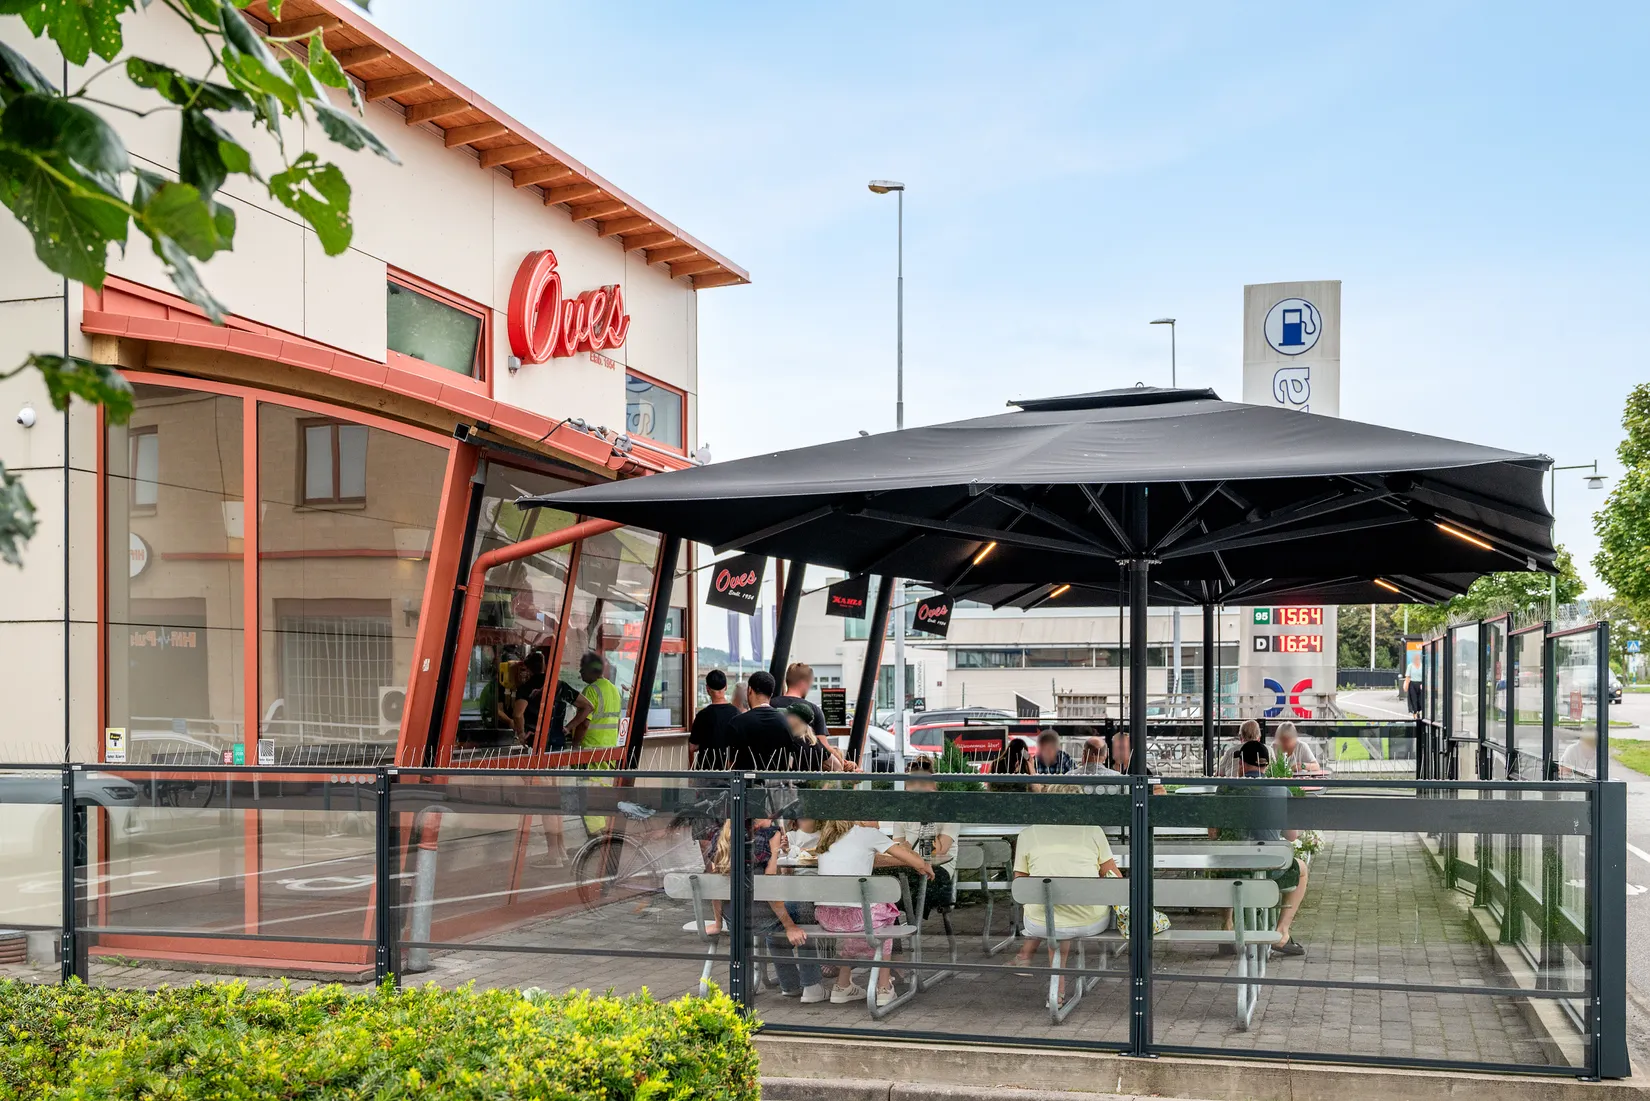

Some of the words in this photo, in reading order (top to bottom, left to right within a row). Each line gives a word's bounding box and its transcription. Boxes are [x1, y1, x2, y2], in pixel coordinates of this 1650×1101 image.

[508, 249, 631, 364] Oves
[715, 568, 757, 593] Oves
[918, 603, 949, 620] Oves
[1255, 611, 1268, 621] 95
[1280, 608, 1321, 625] 15.64
[1256, 638, 1267, 650] D
[1279, 635, 1321, 652] 16.24
